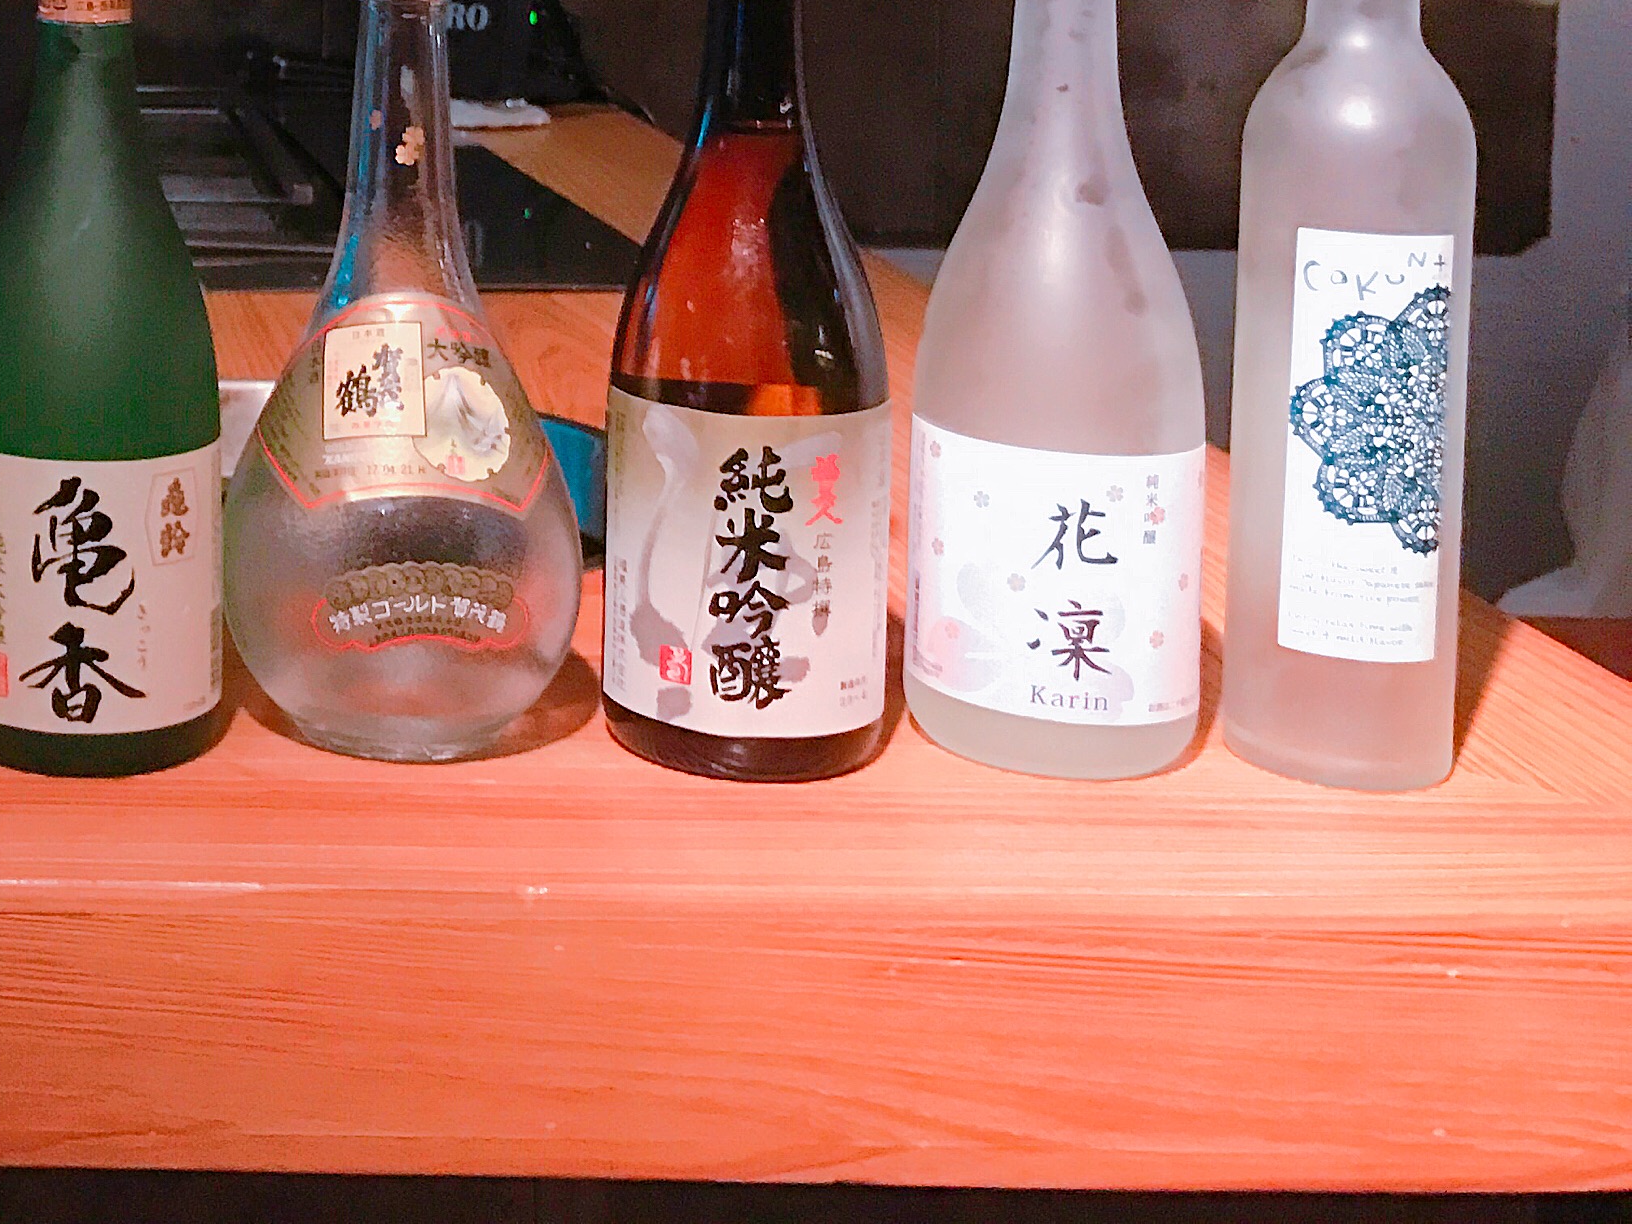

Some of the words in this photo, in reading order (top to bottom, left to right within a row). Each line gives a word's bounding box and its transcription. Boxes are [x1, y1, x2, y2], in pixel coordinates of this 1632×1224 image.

[708, 446, 795, 710] 純米吟醸
[1029, 683, 1108, 712] Karin
